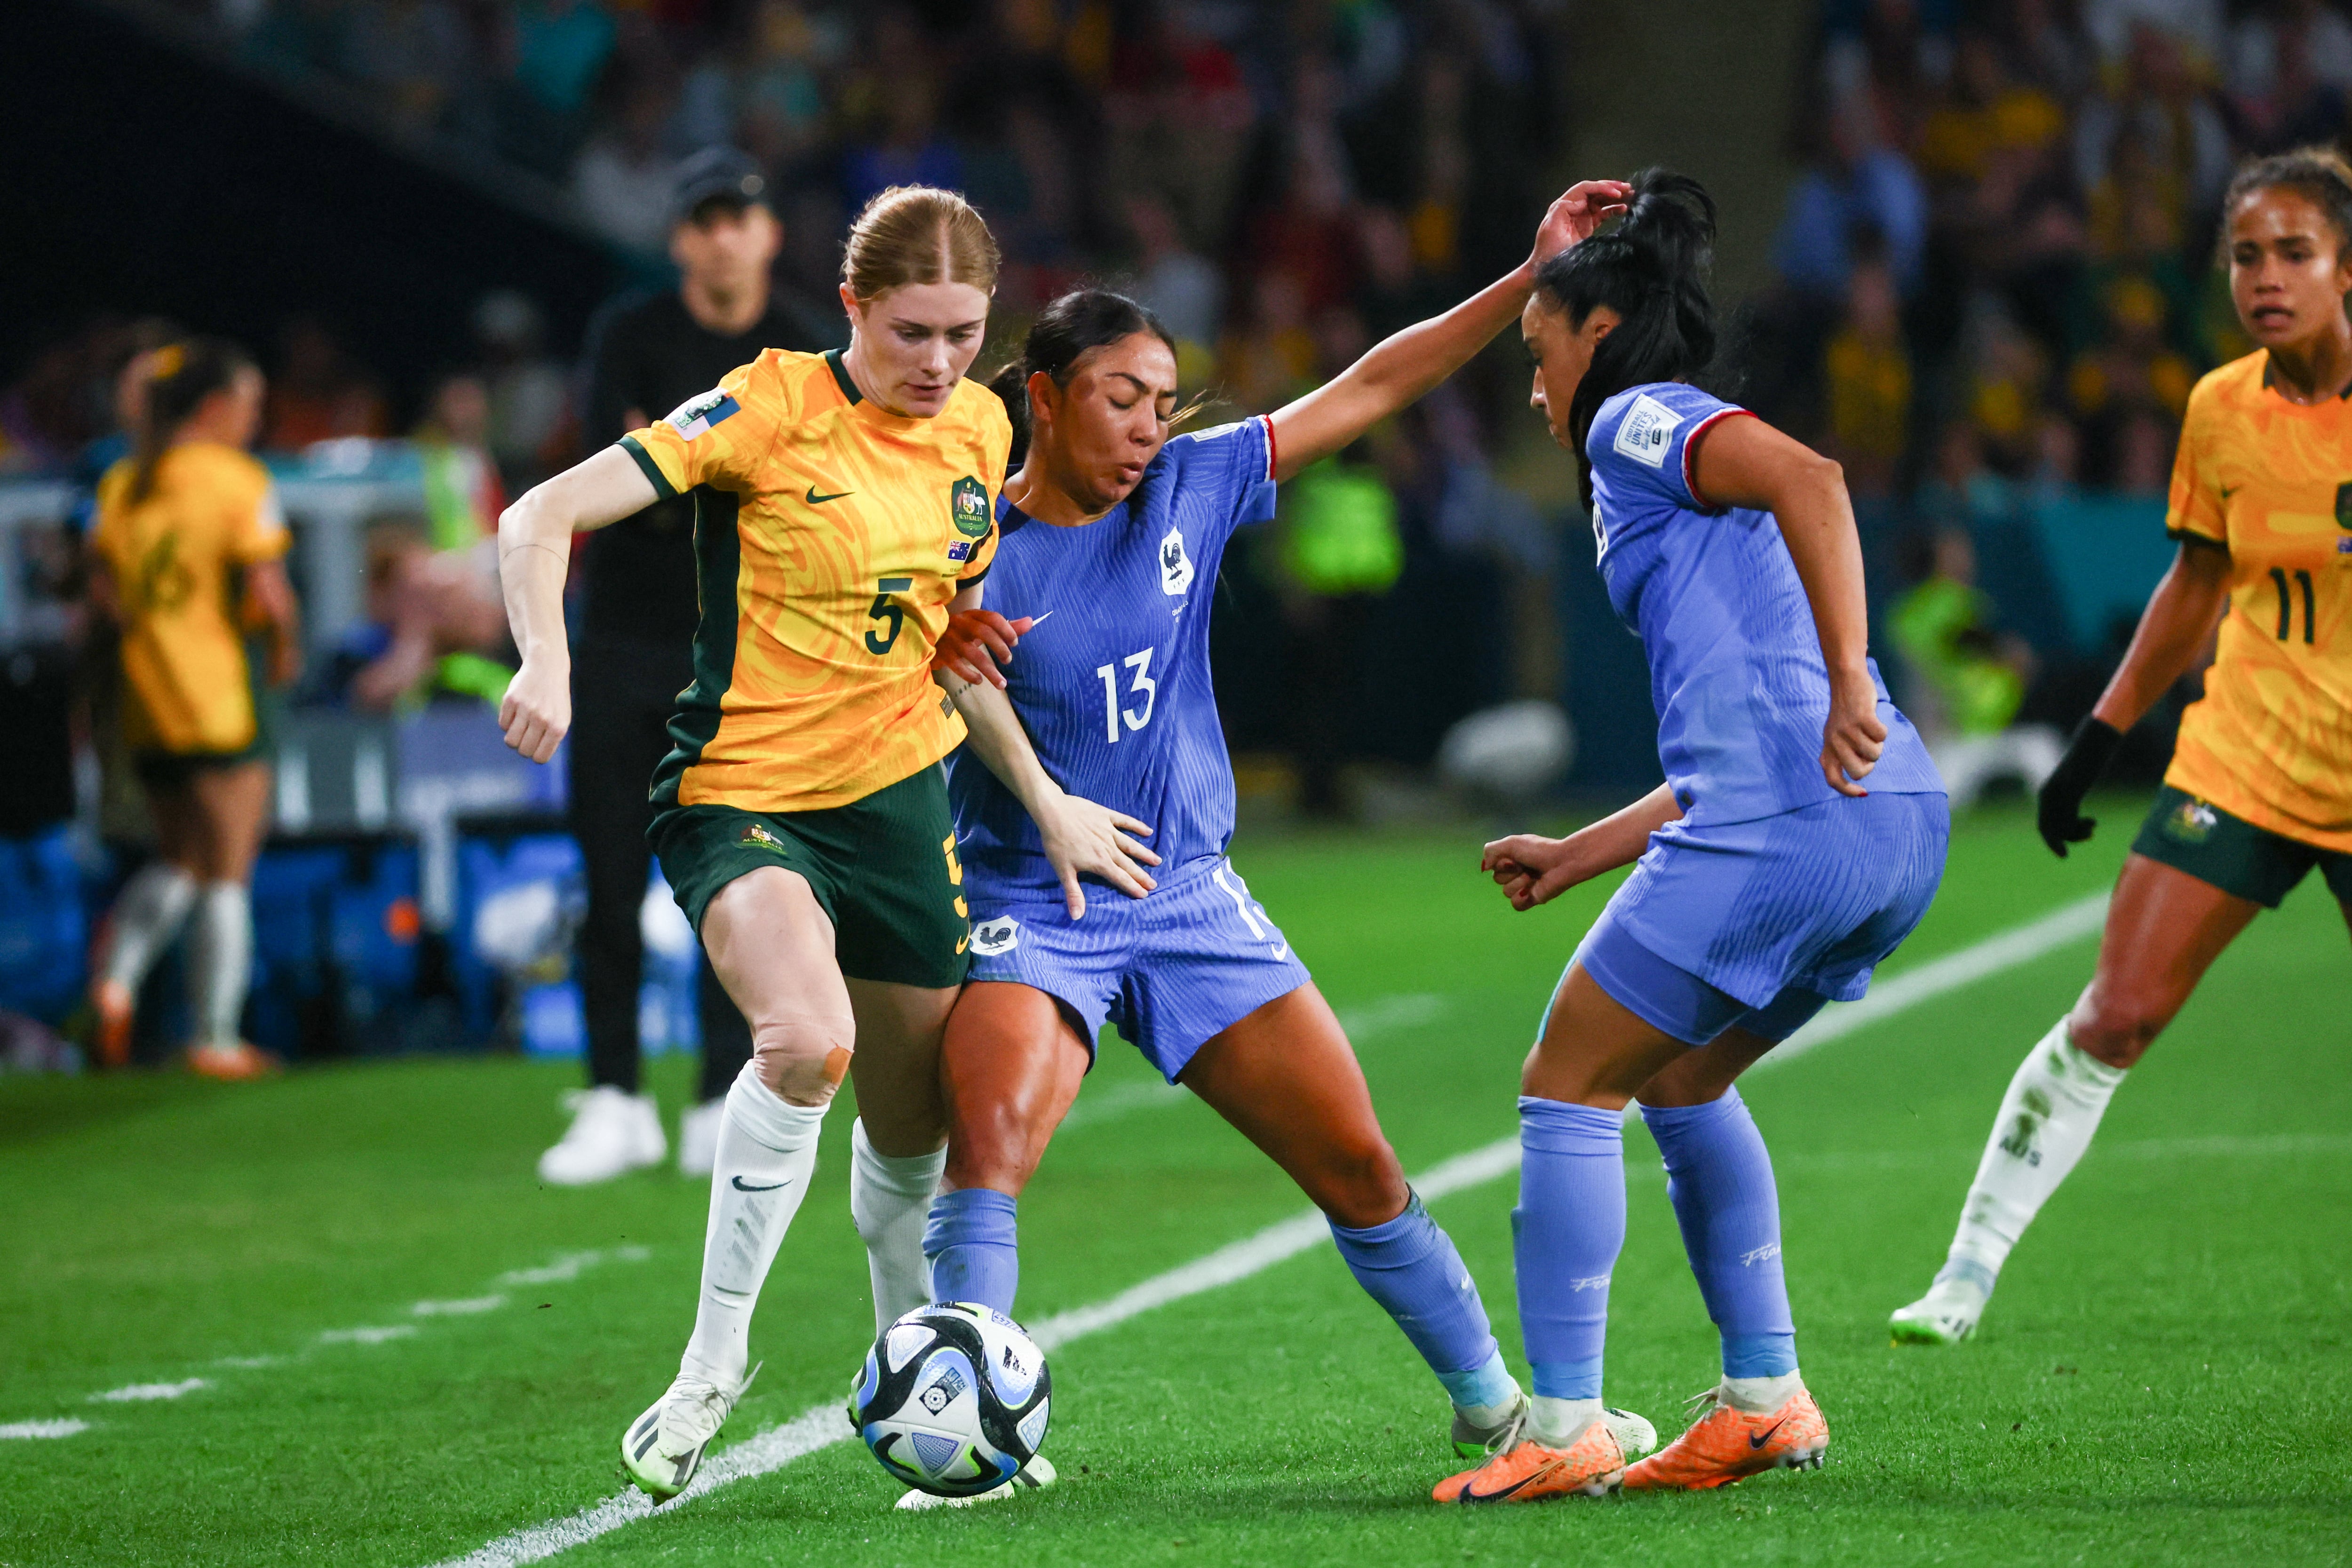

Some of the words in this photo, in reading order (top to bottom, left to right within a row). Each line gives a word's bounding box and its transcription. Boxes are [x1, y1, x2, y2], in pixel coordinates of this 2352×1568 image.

[1625, 410, 1644, 442] FOOTBALL
[1631, 412, 1652, 445] UNITES
[958, 513, 983, 522] AUSTRALIA
[865, 578, 913, 655] 5
[2268, 566, 2315, 645] 11
[1097, 646, 1156, 744] 13
